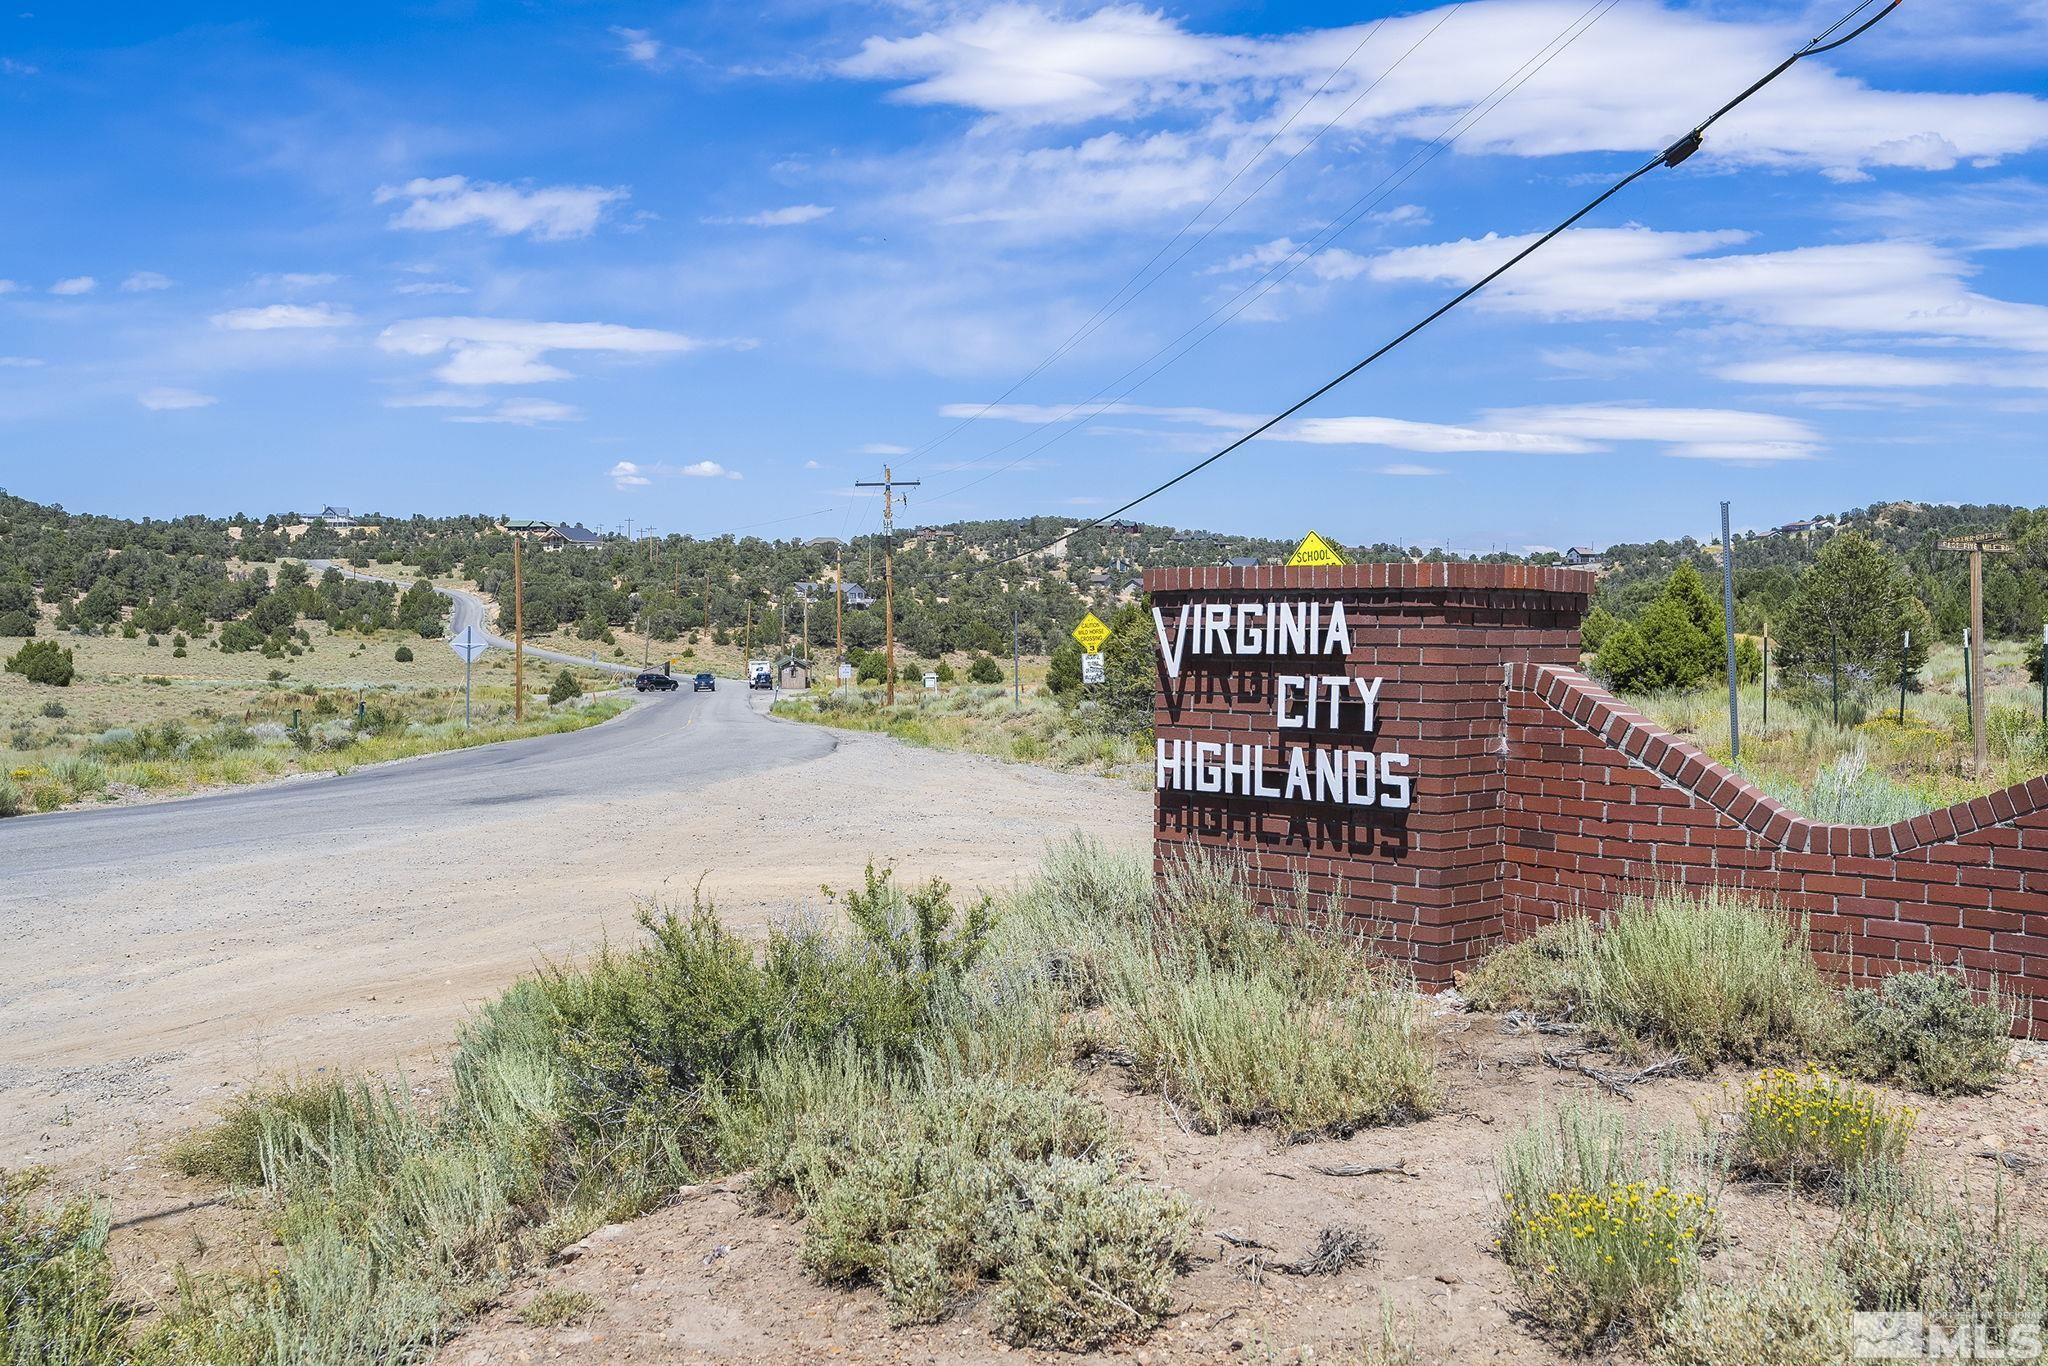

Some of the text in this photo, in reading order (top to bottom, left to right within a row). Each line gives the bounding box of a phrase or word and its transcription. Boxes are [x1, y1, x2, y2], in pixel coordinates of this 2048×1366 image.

[1296, 549, 1331, 563] SCHOOL
[1963, 542, 1978, 550] FIVE
[1081, 634, 1103, 642] CROSSING
[1152, 601, 1352, 678] VIRGINIA
[1277, 676, 1383, 732] CITY
[1157, 738, 1411, 809] HIGHLANDS
